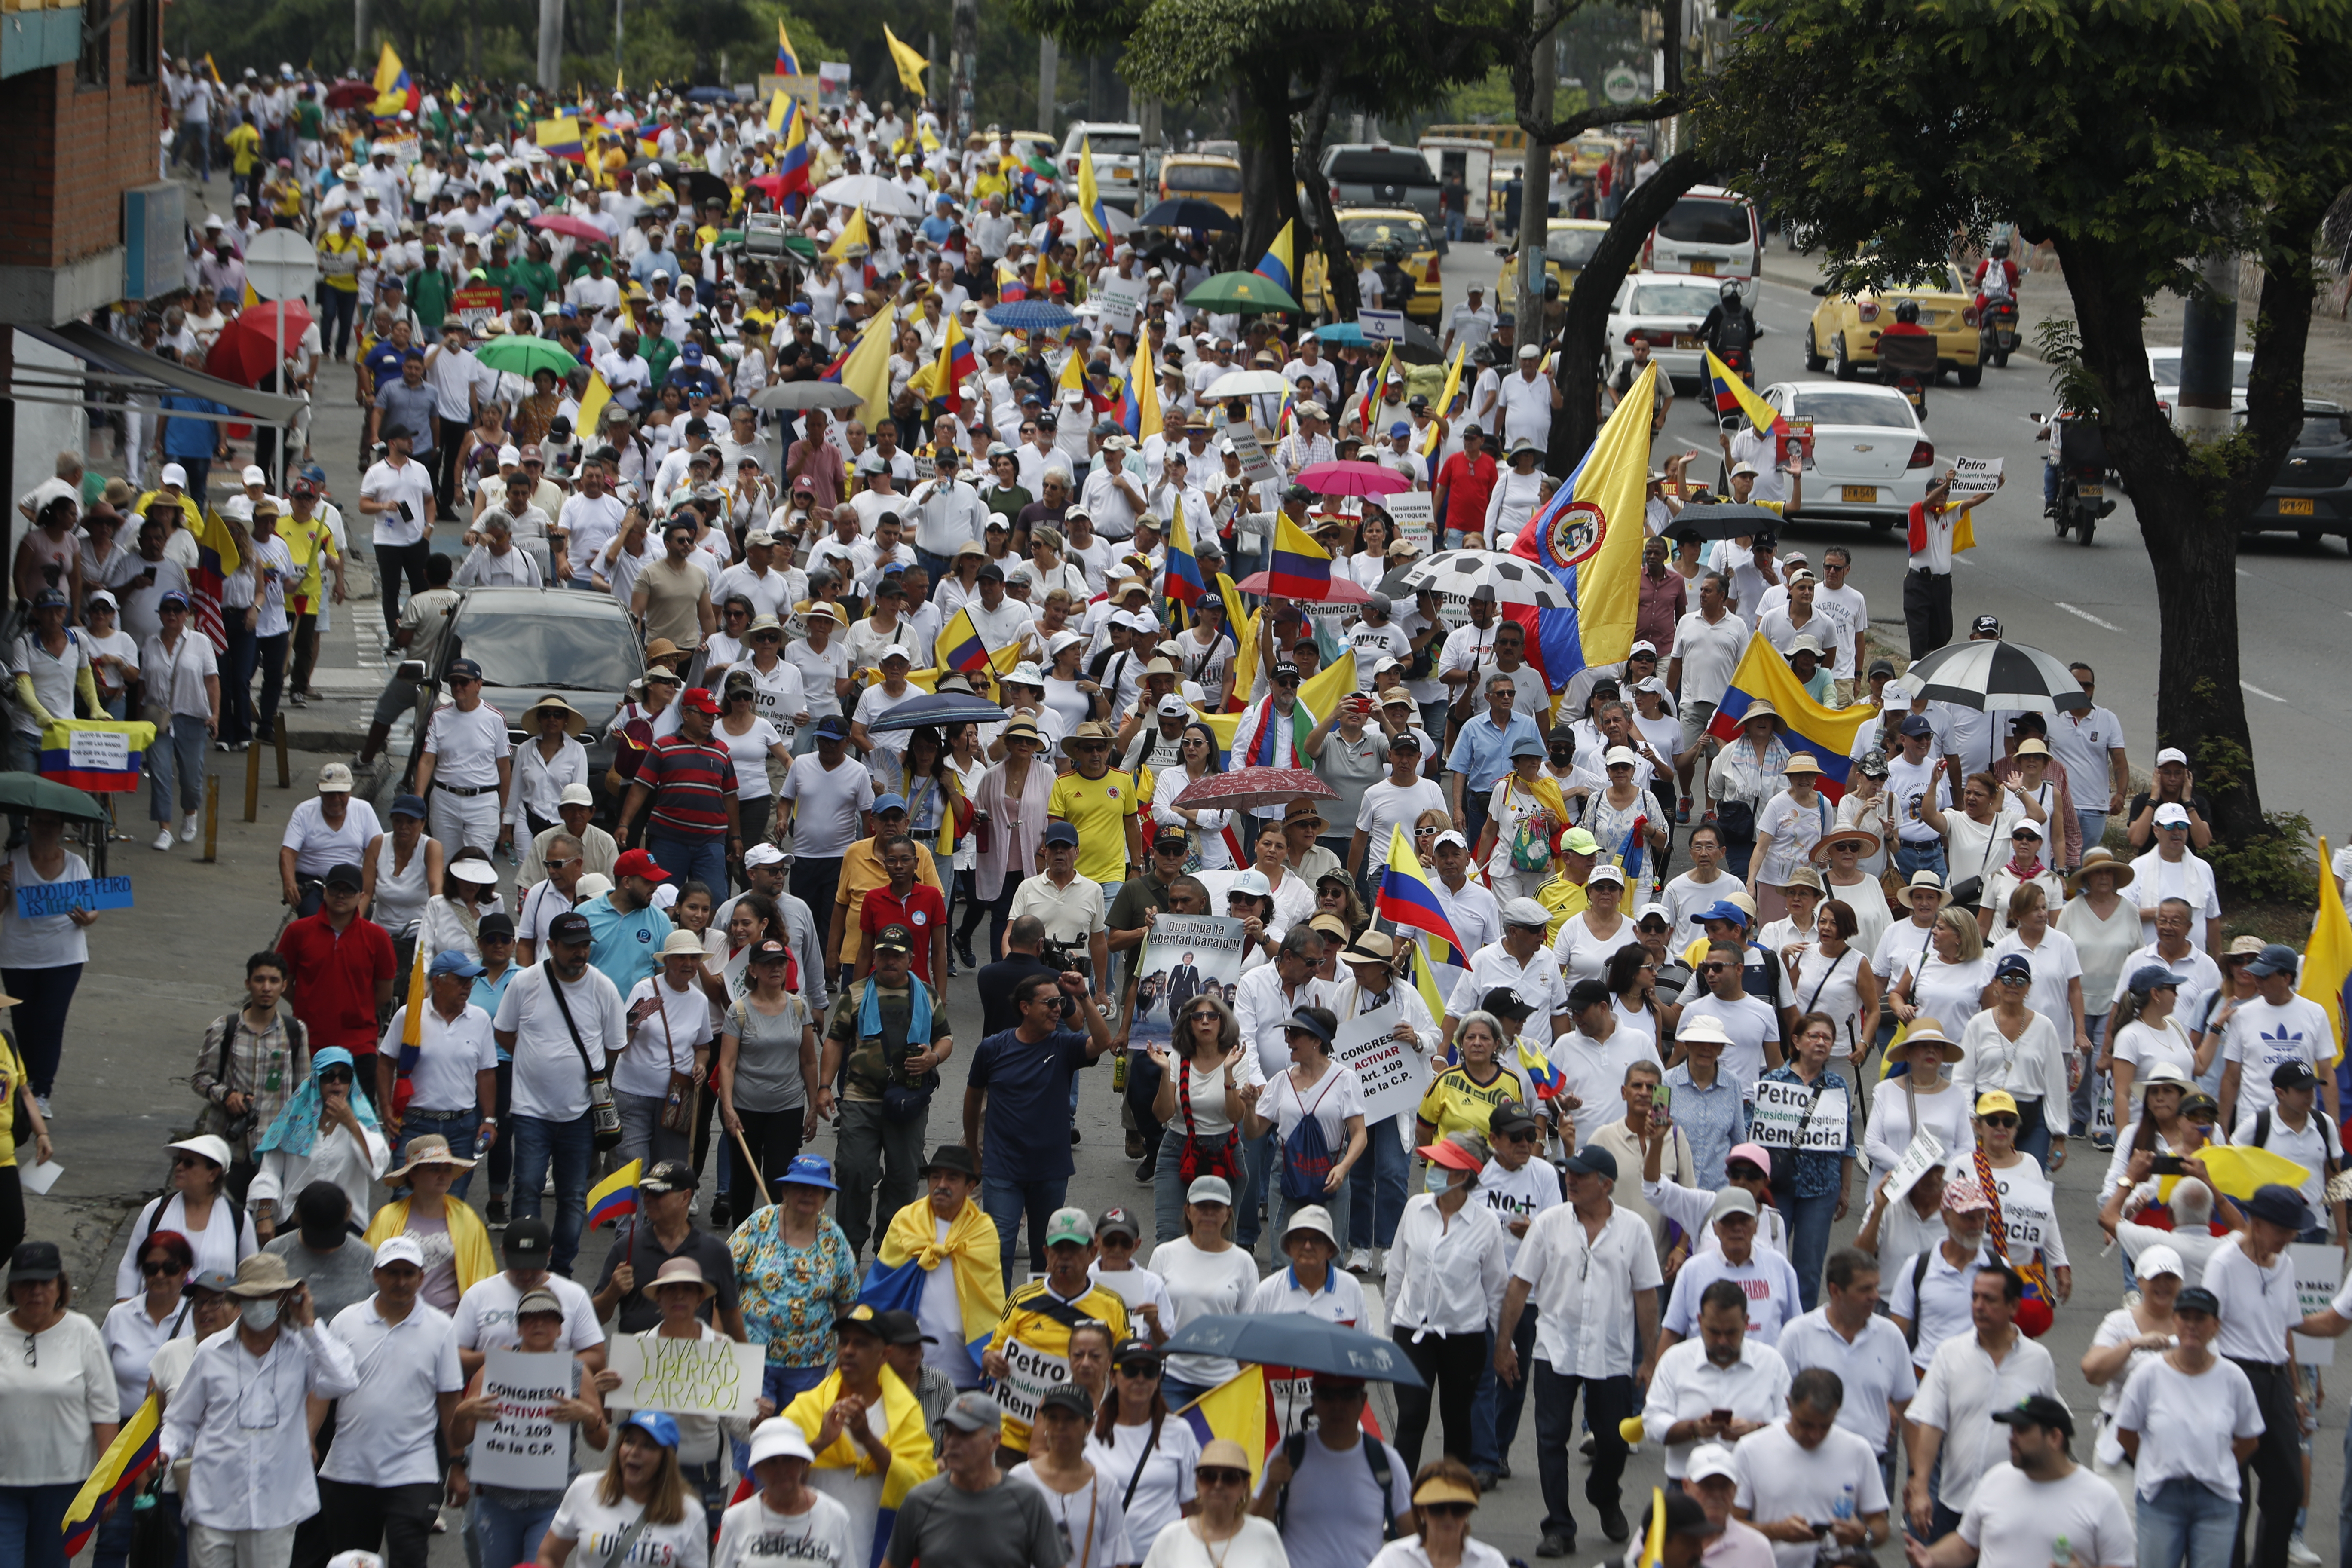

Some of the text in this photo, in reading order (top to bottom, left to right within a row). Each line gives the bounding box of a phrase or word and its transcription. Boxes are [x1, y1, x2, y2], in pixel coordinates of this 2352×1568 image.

[1250, 462, 1268, 471] EMPLEO
[1957, 457, 1987, 470] Petro
[1661, 483, 1676, 494] ORTE
[1952, 478, 1996, 490] Renuncia
[1547, 523, 1564, 566] DE COLOMBIA
[1442, 591, 1466, 605] etro
[1303, 603, 1357, 615] Renuncia
[784, 626, 806, 638] Preside
[1353, 634, 1389, 649] NIKE
[1902, 783, 1920, 800] LIBERTAD
[59, 882, 75, 899] LO
[76, 880, 90, 896] DE
[94, 876, 131, 895] PETRO
[1240, 873, 1251, 885] B
[27, 900, 43, 916] ES
[1168, 921, 1225, 935] Que Viva la
[1150, 933, 1241, 951] Libertad Carajo!!!
[1341, 1034, 1393, 1061] CONGRES
[1354, 1046, 1400, 1071] ACTIVAR
[1361, 1060, 1403, 1084] Art. 109
[1363, 1072, 1412, 1098] de la C.P.
[1757, 1083, 1808, 1108] Petro
[1755, 1107, 1845, 1127] Presidente egitimo
[707, 1342, 733, 1364] LA
[1006, 1341, 1065, 1381] Petro
[643, 1356, 741, 1387] LIBERTAD
[487, 1381, 565, 1402] CONGRESO
[634, 1377, 740, 1412] CARAJO!
[1006, 1375, 1046, 1398] resident
[492, 1420, 552, 1438] Art. 109
[486, 1437, 556, 1456] de la C.P.
[589, 1531, 673, 1567] FURTES
